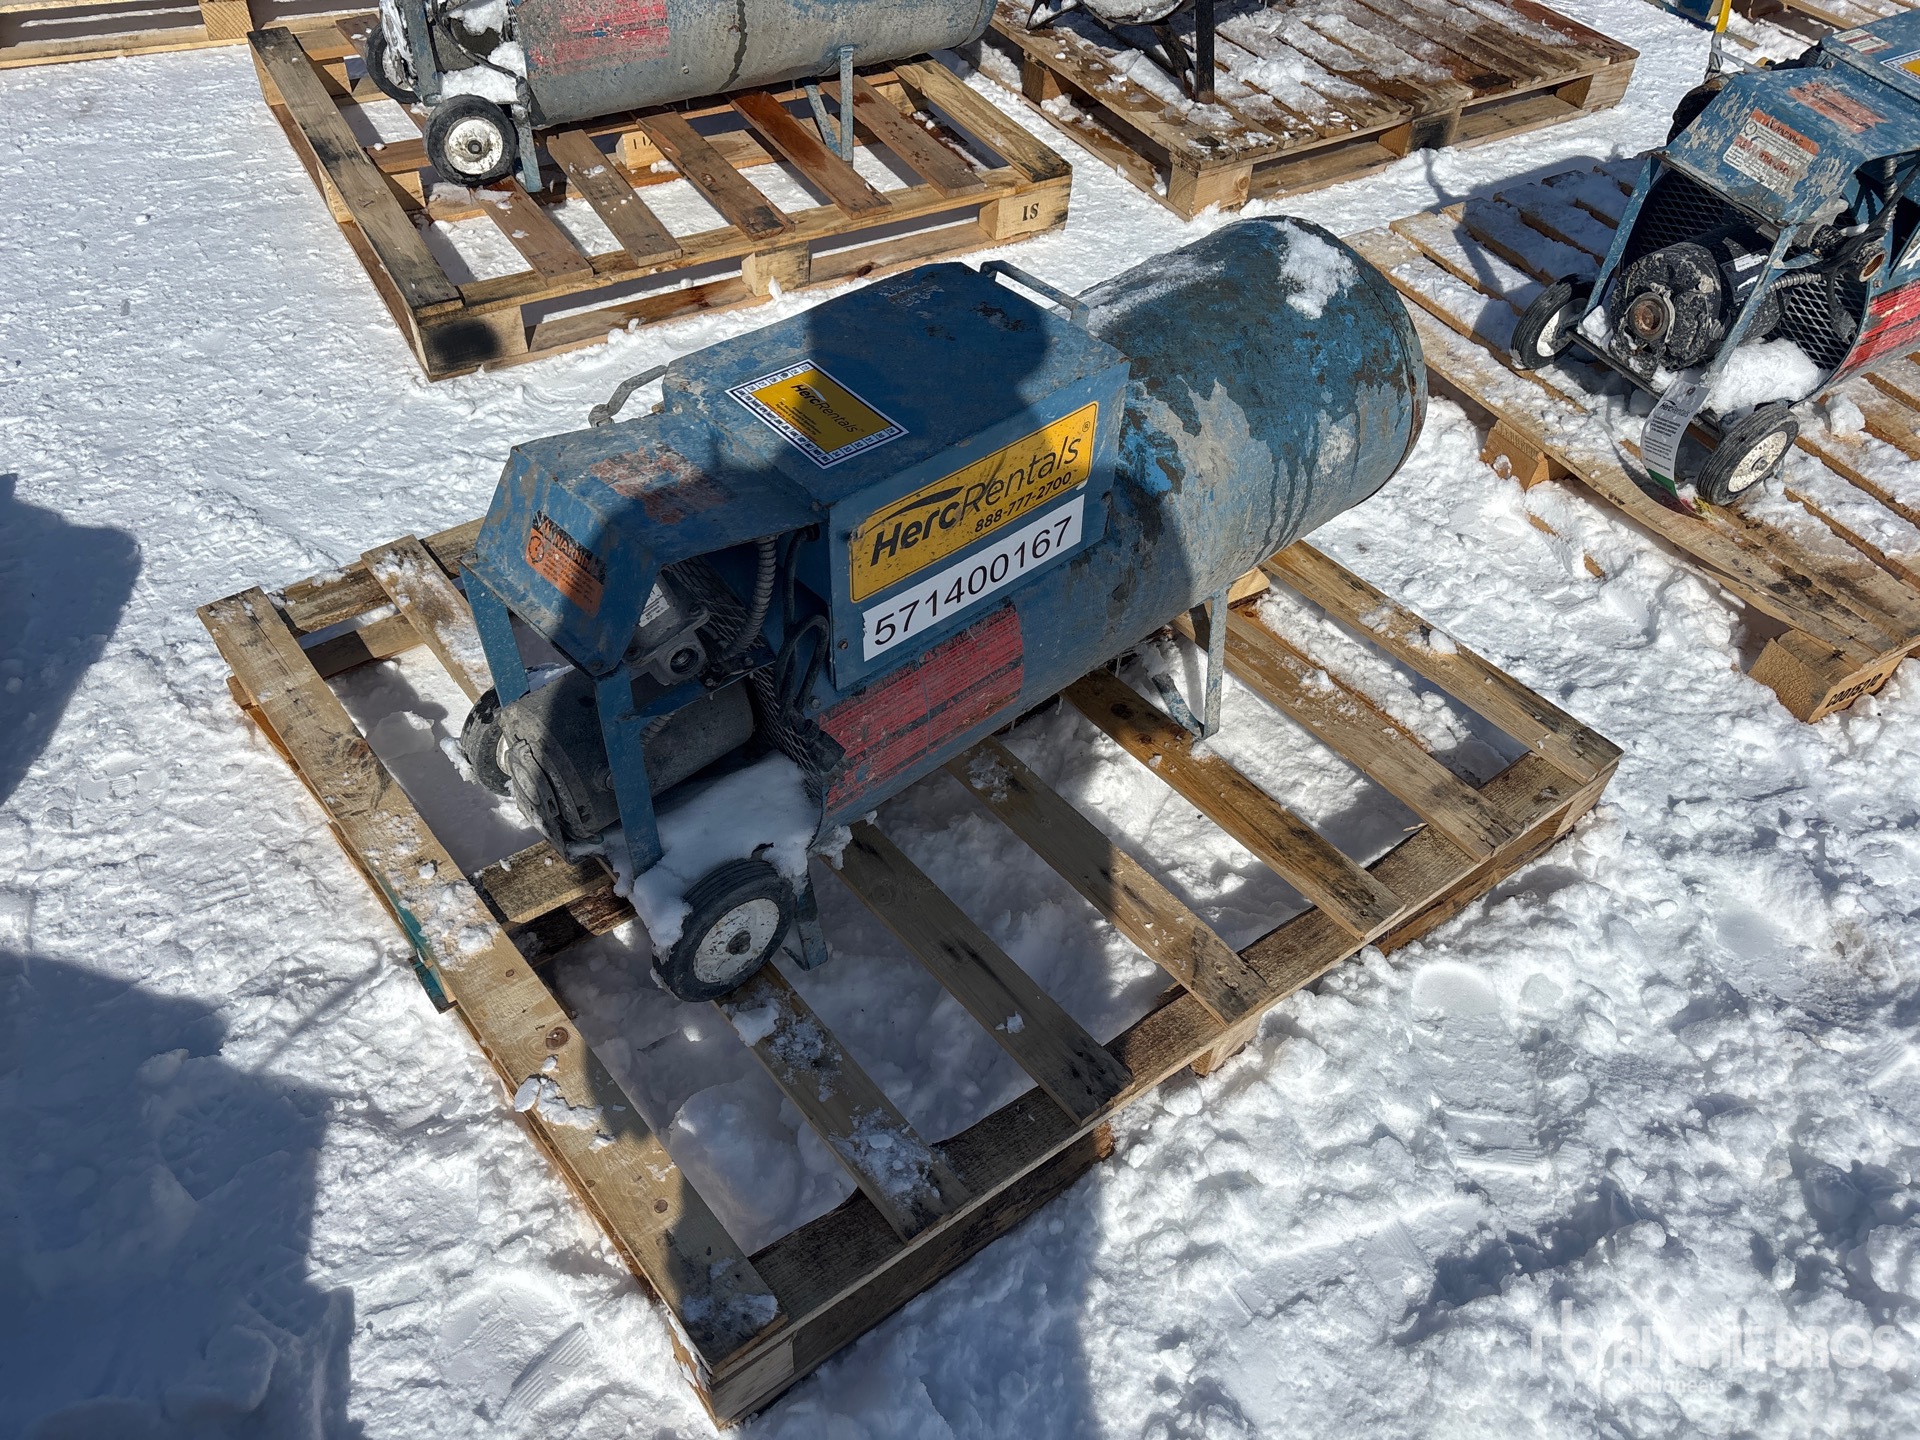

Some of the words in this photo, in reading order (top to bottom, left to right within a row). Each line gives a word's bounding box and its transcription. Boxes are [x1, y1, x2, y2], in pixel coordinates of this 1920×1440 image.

[1022, 203, 1039, 221] IS
[790, 384, 858, 433] HercRentals
[870, 436, 1082, 567] HercRentals
[975, 472, 1072, 533] 888-777-2700
[874, 516, 1072, 646] 571400167
